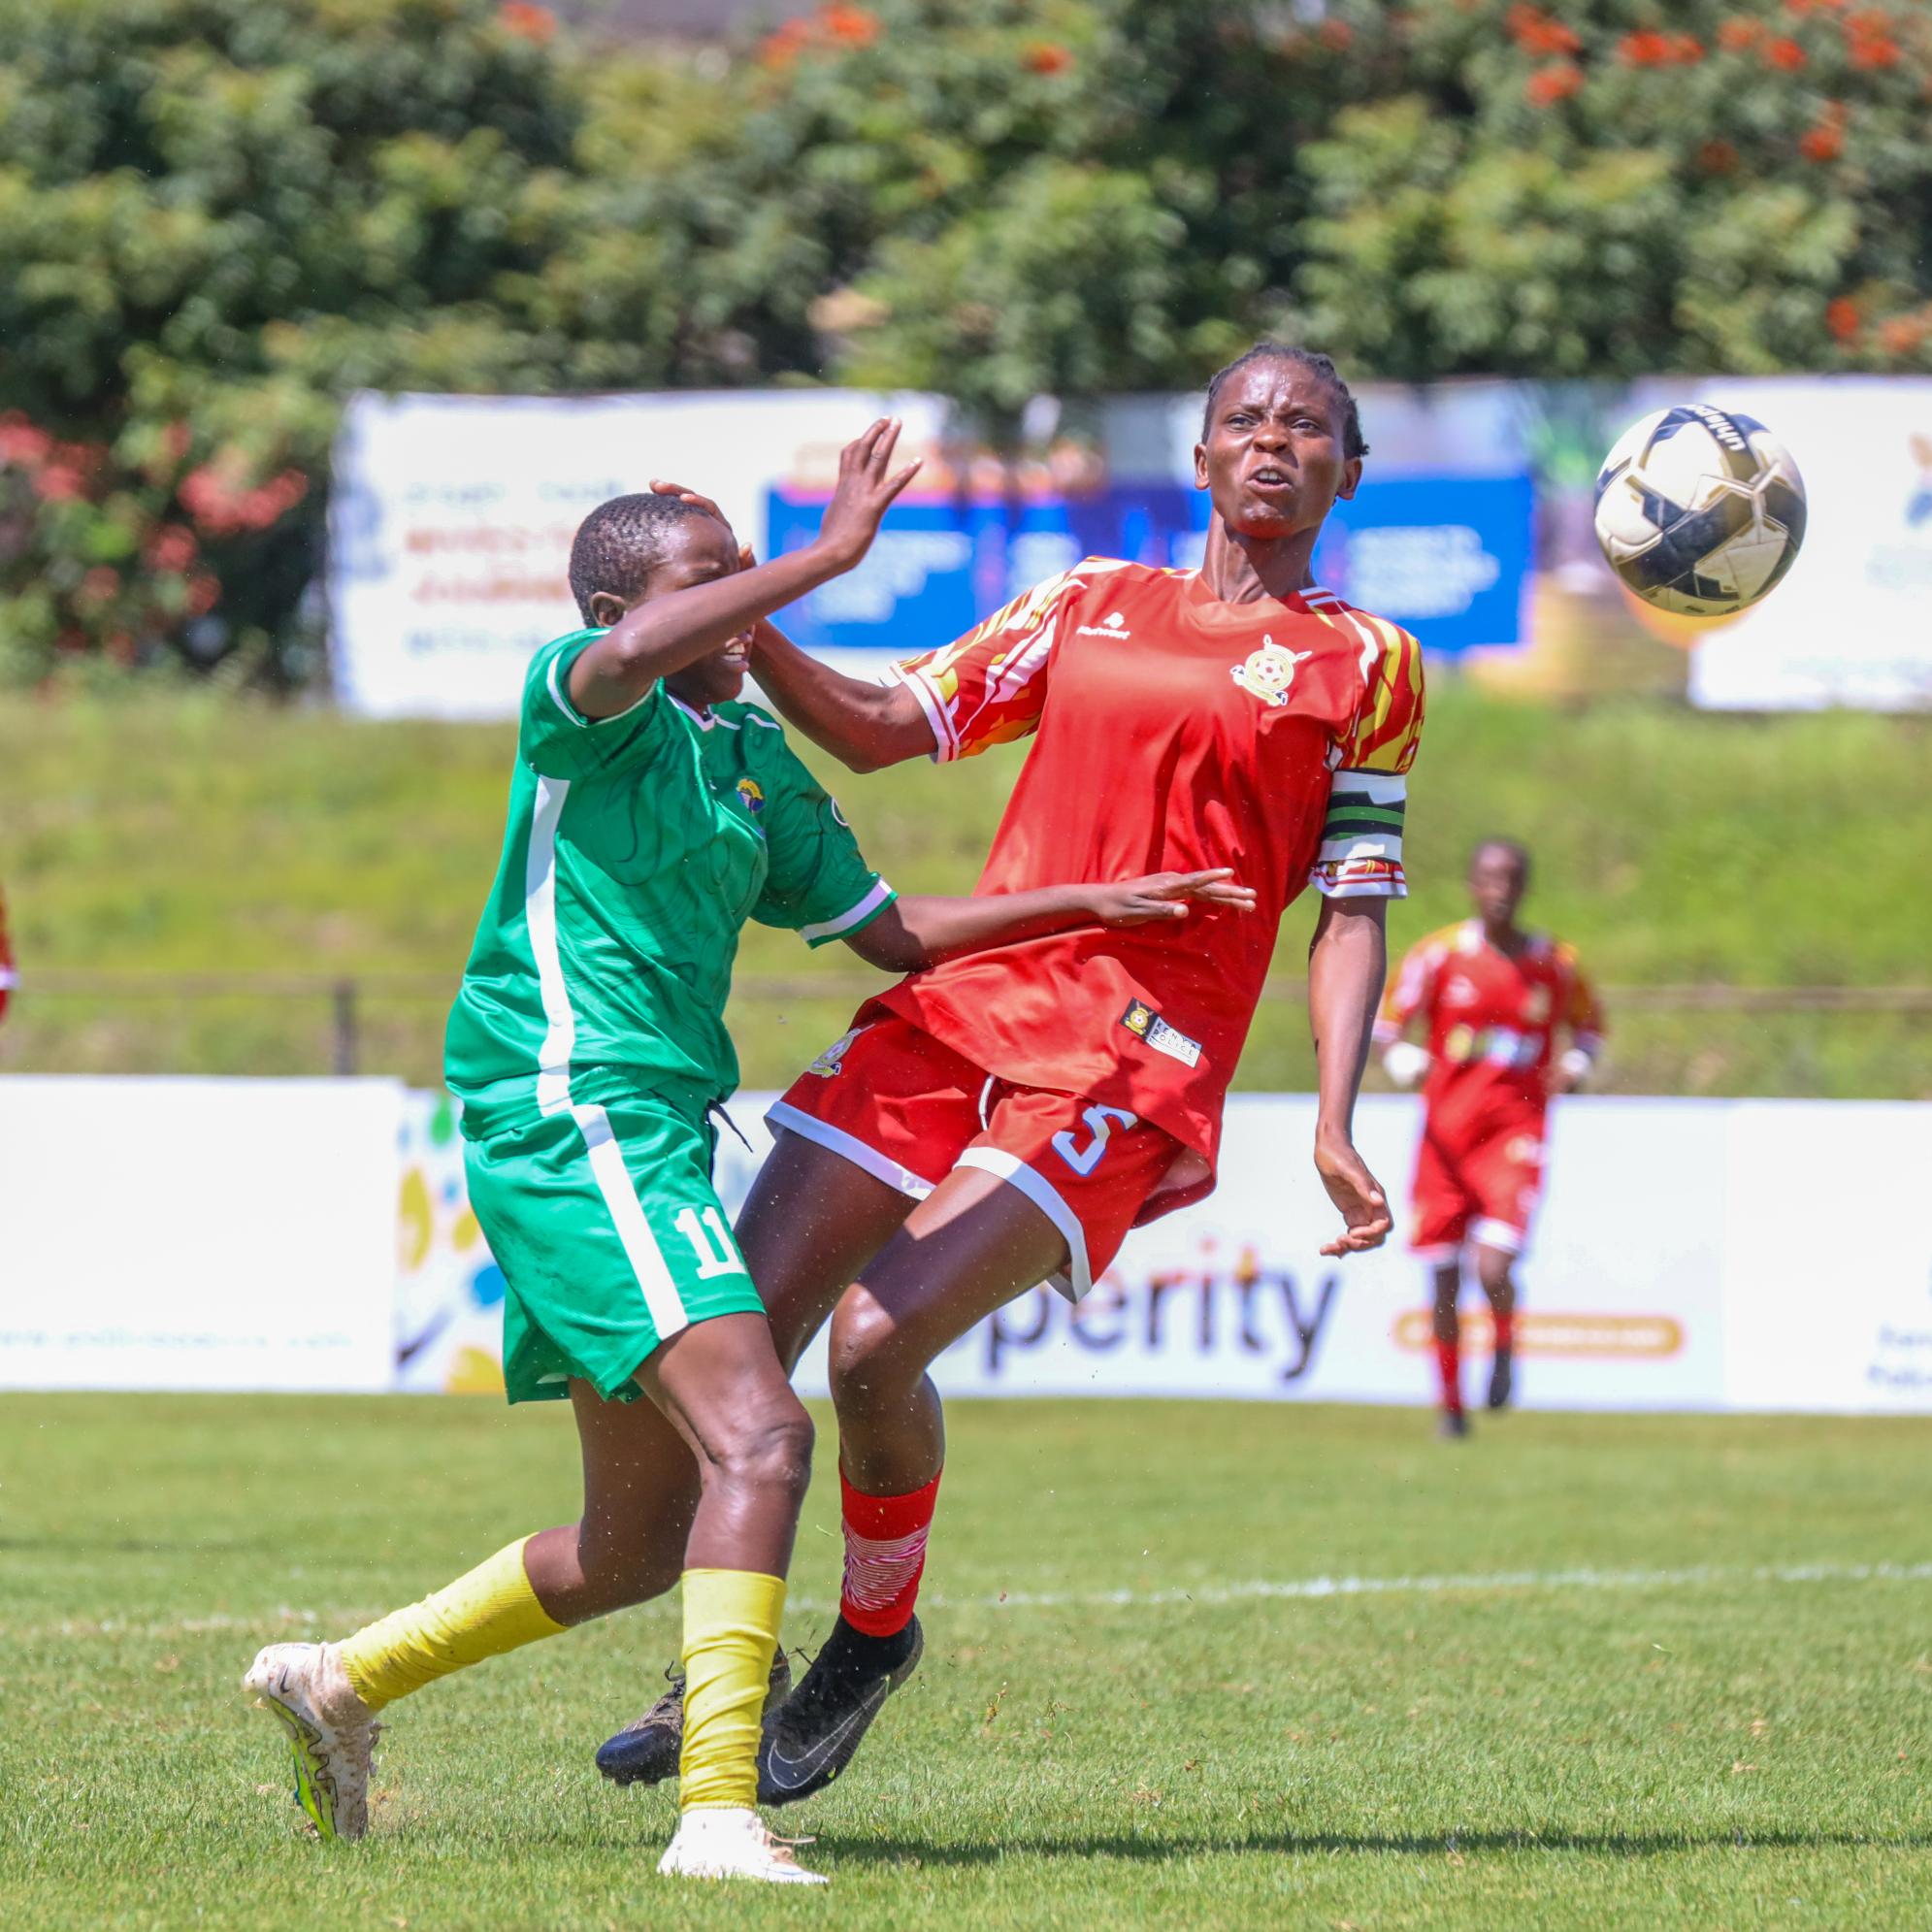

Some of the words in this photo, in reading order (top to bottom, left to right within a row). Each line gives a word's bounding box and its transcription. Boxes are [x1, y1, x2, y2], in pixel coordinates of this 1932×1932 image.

[1153, 1028, 1193, 1057] POLICE
[1157, 1020, 1196, 1049] KENYA
[673, 1205, 748, 1280] 11
[980, 1236, 1338, 1381] perity
